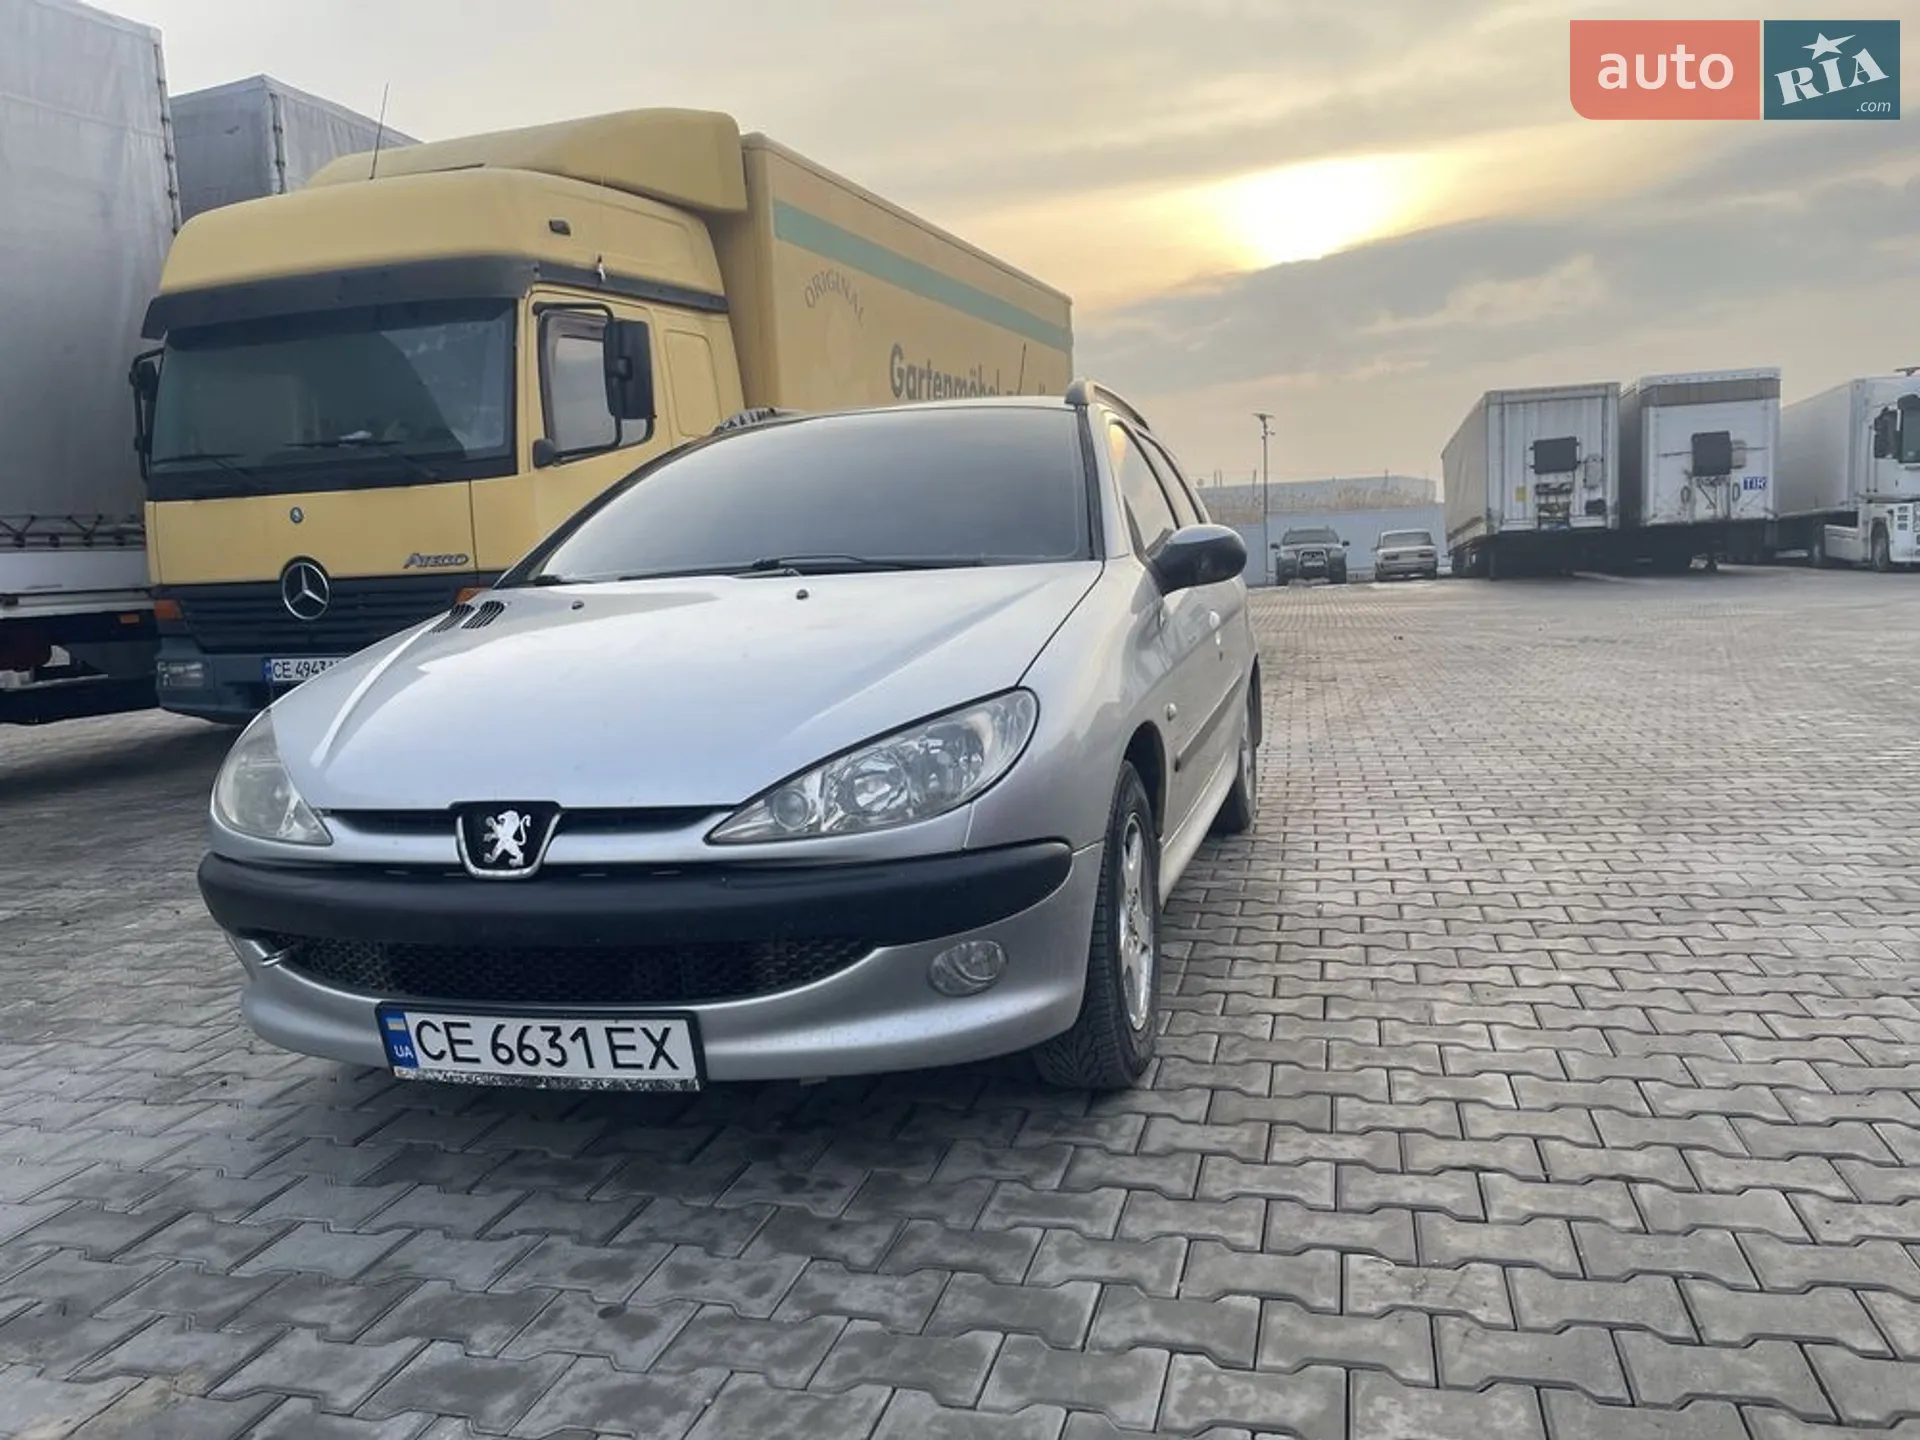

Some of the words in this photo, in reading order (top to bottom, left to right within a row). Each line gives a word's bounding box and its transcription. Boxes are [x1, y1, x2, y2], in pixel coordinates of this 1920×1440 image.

[273, 662, 292, 679] CE
[393, 1044, 414, 1060] UA
[415, 1019, 482, 1064] CE
[490, 1023, 595, 1069] 6631
[604, 1027, 680, 1071] EX
